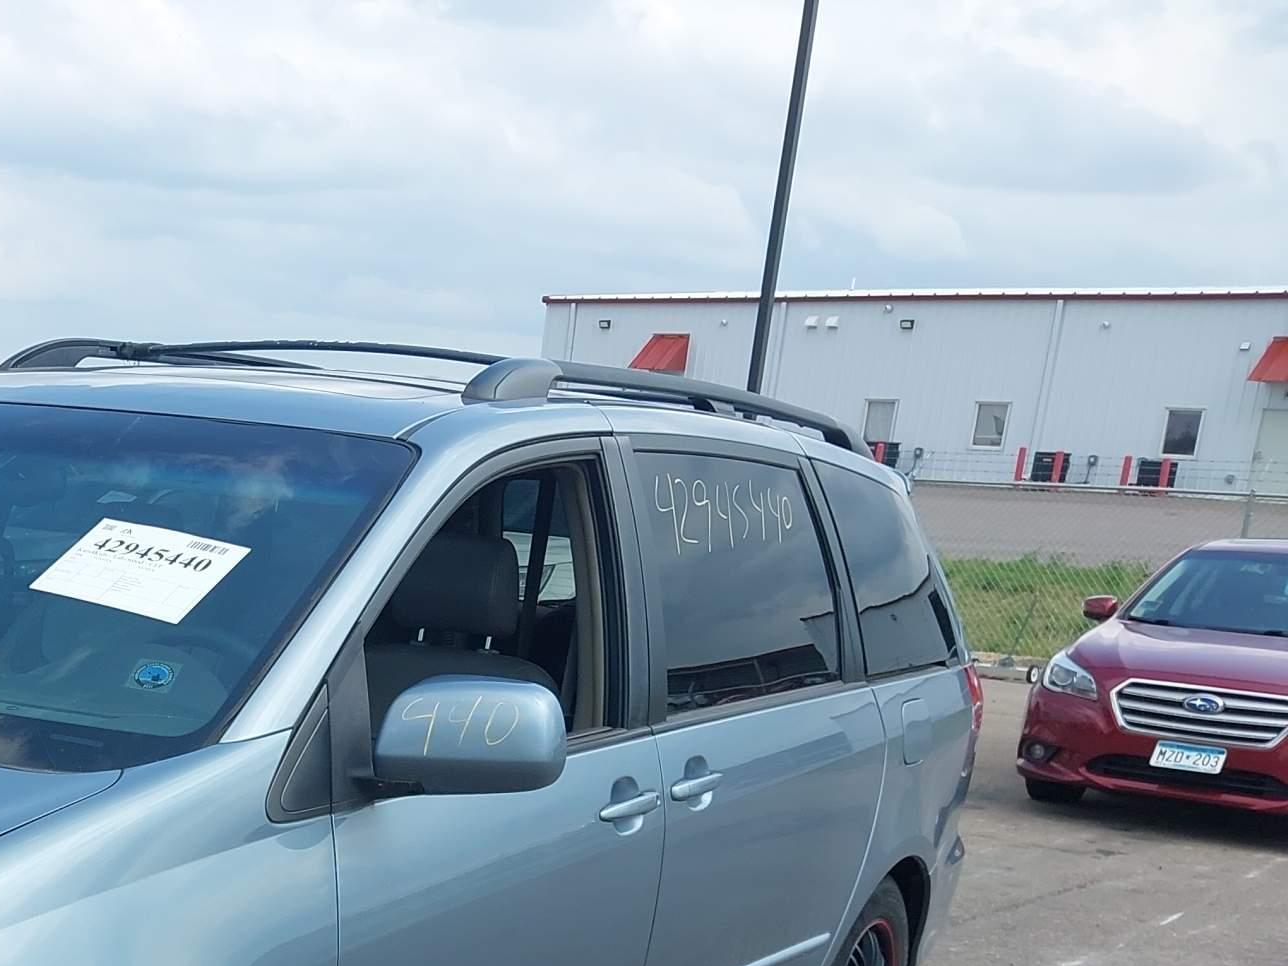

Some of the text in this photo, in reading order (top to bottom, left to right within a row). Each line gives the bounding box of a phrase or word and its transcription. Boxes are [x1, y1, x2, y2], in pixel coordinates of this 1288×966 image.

[654, 472, 793, 556] 42945440
[93, 537, 213, 573] 42945440
[1155, 748, 1185, 764] MZD
[1192, 752, 1221, 768] 203
